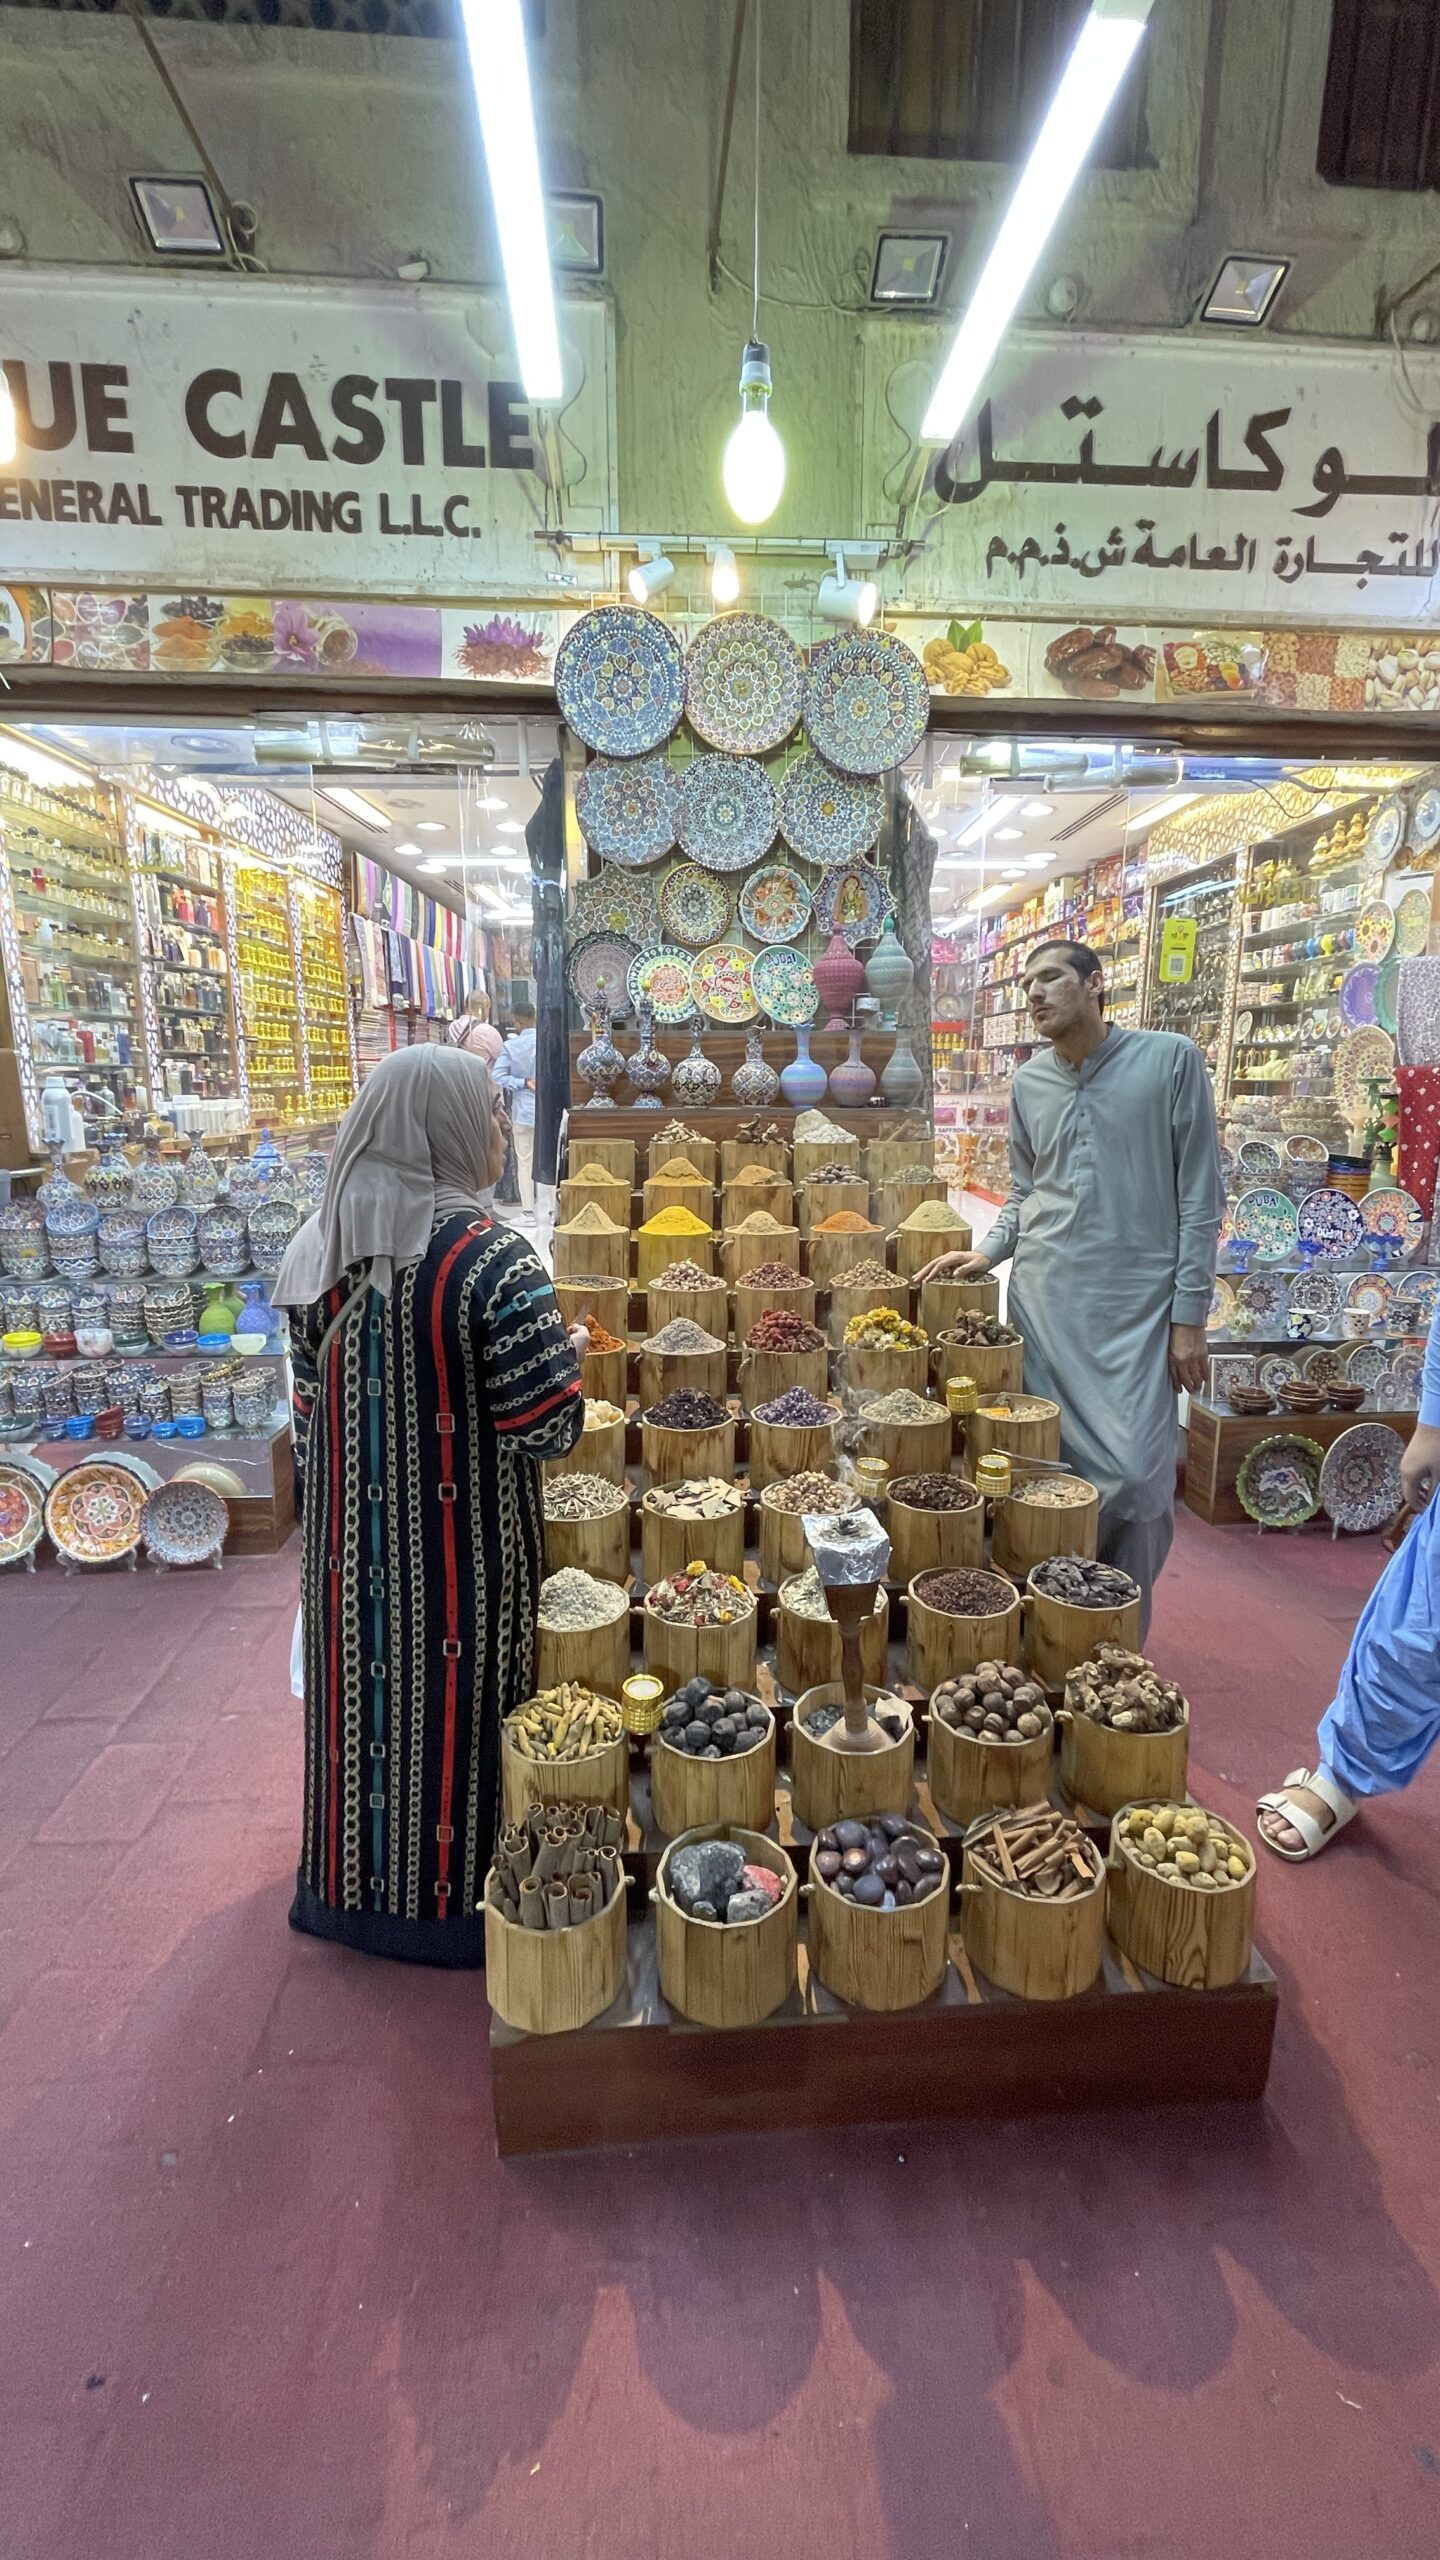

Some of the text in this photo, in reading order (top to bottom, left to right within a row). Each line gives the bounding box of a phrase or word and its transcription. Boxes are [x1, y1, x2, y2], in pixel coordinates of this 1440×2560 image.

[185, 368, 534, 470] CASTLE
[0, 478, 481, 539] ENERAL TRADING L.L.C.
[1132, 518, 1257, 574] العامة
